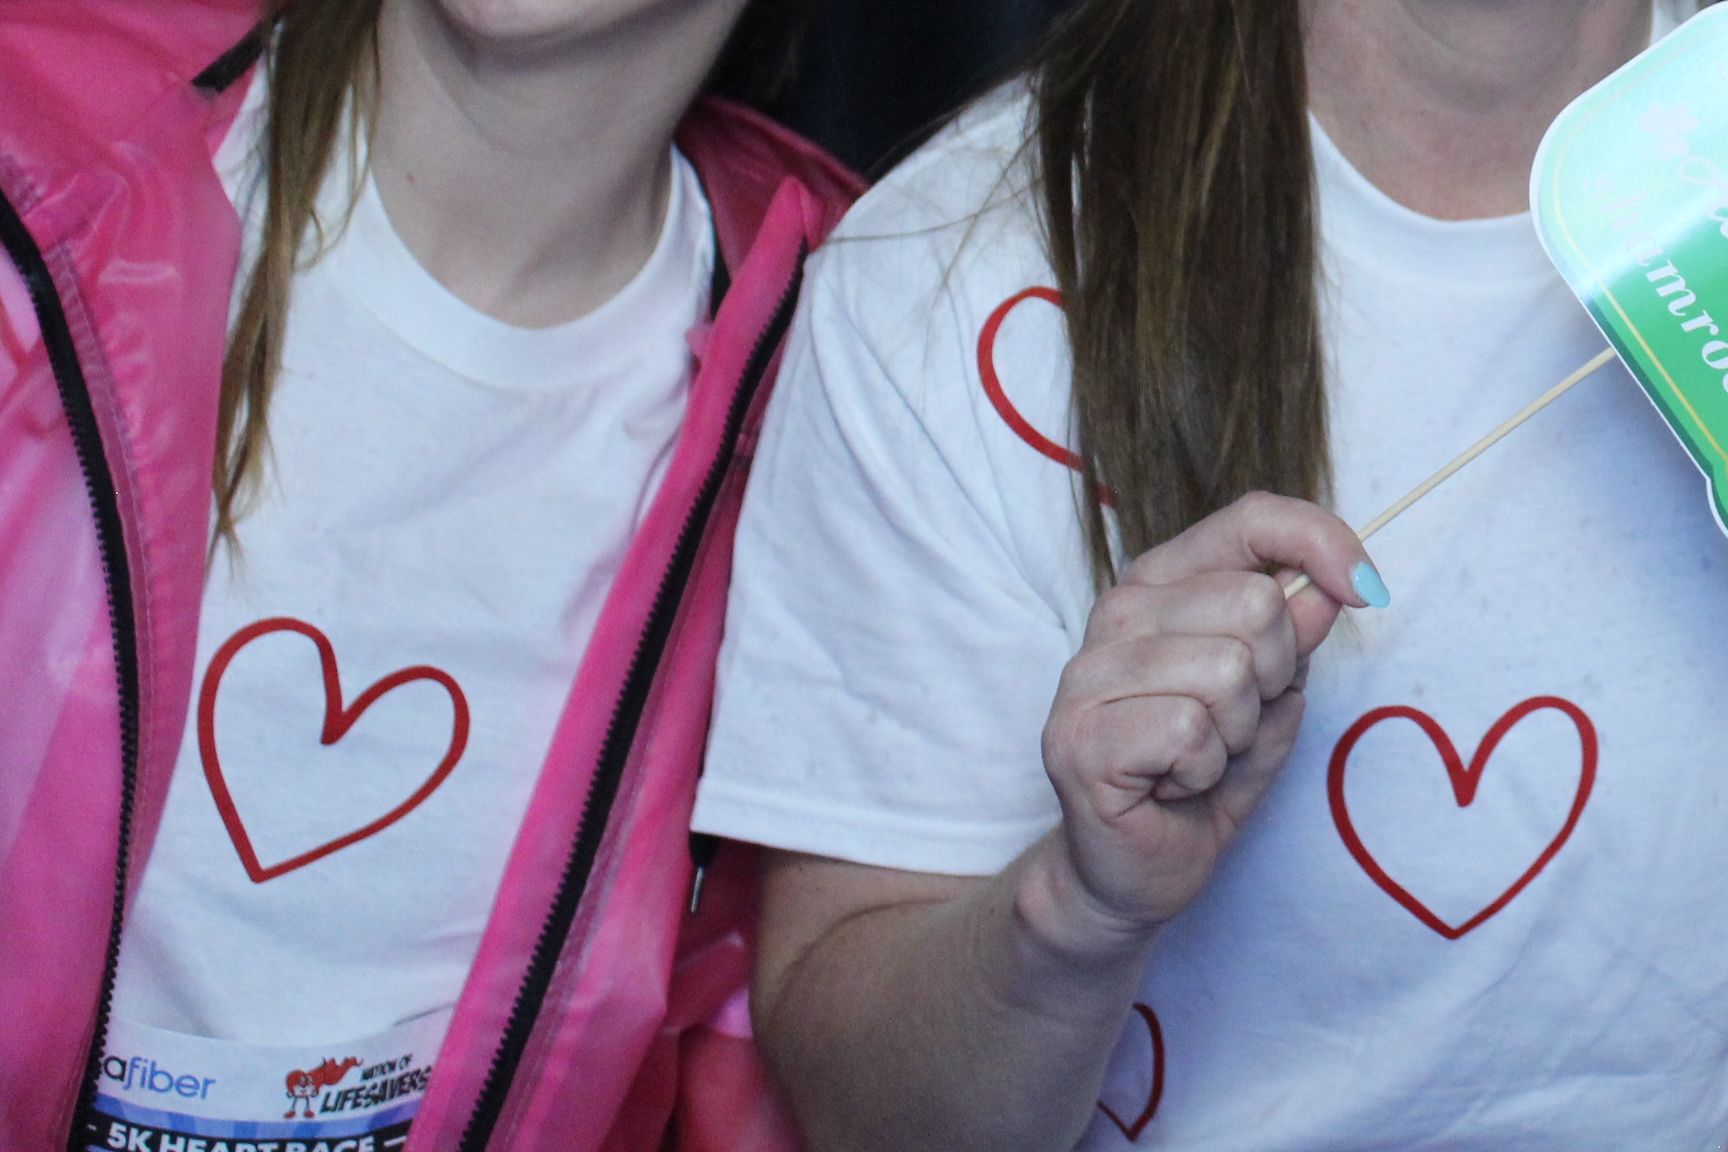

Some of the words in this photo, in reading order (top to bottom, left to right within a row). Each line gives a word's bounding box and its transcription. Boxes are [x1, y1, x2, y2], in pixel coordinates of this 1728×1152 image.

[102, 1055, 217, 1100] afiber
[319, 1065, 432, 1113] LIFESAVERS
[107, 1121, 153, 1152] 5K
